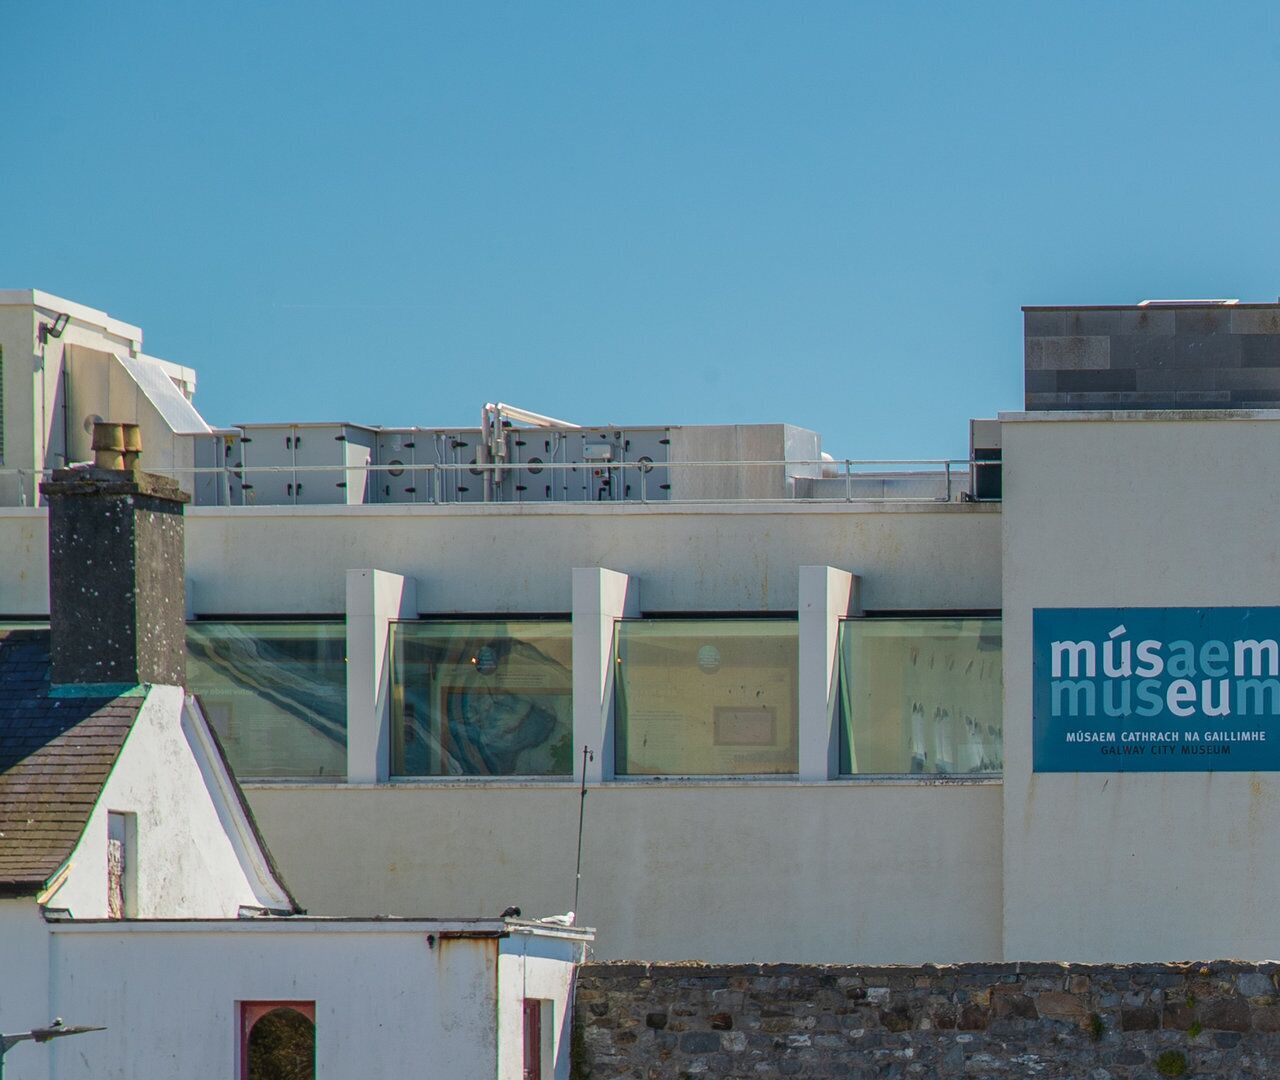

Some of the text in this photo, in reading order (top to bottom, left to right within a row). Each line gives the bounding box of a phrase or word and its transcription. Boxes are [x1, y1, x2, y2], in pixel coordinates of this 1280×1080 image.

[1050, 624, 1279, 678] músaem
[1050, 678, 1280, 717] museum
[1066, 730, 1266, 742] MÚSAEM CATHRACH NA GAILLIMHE
[1100, 744, 1231, 755] GALWAY CITY MUSEUM
